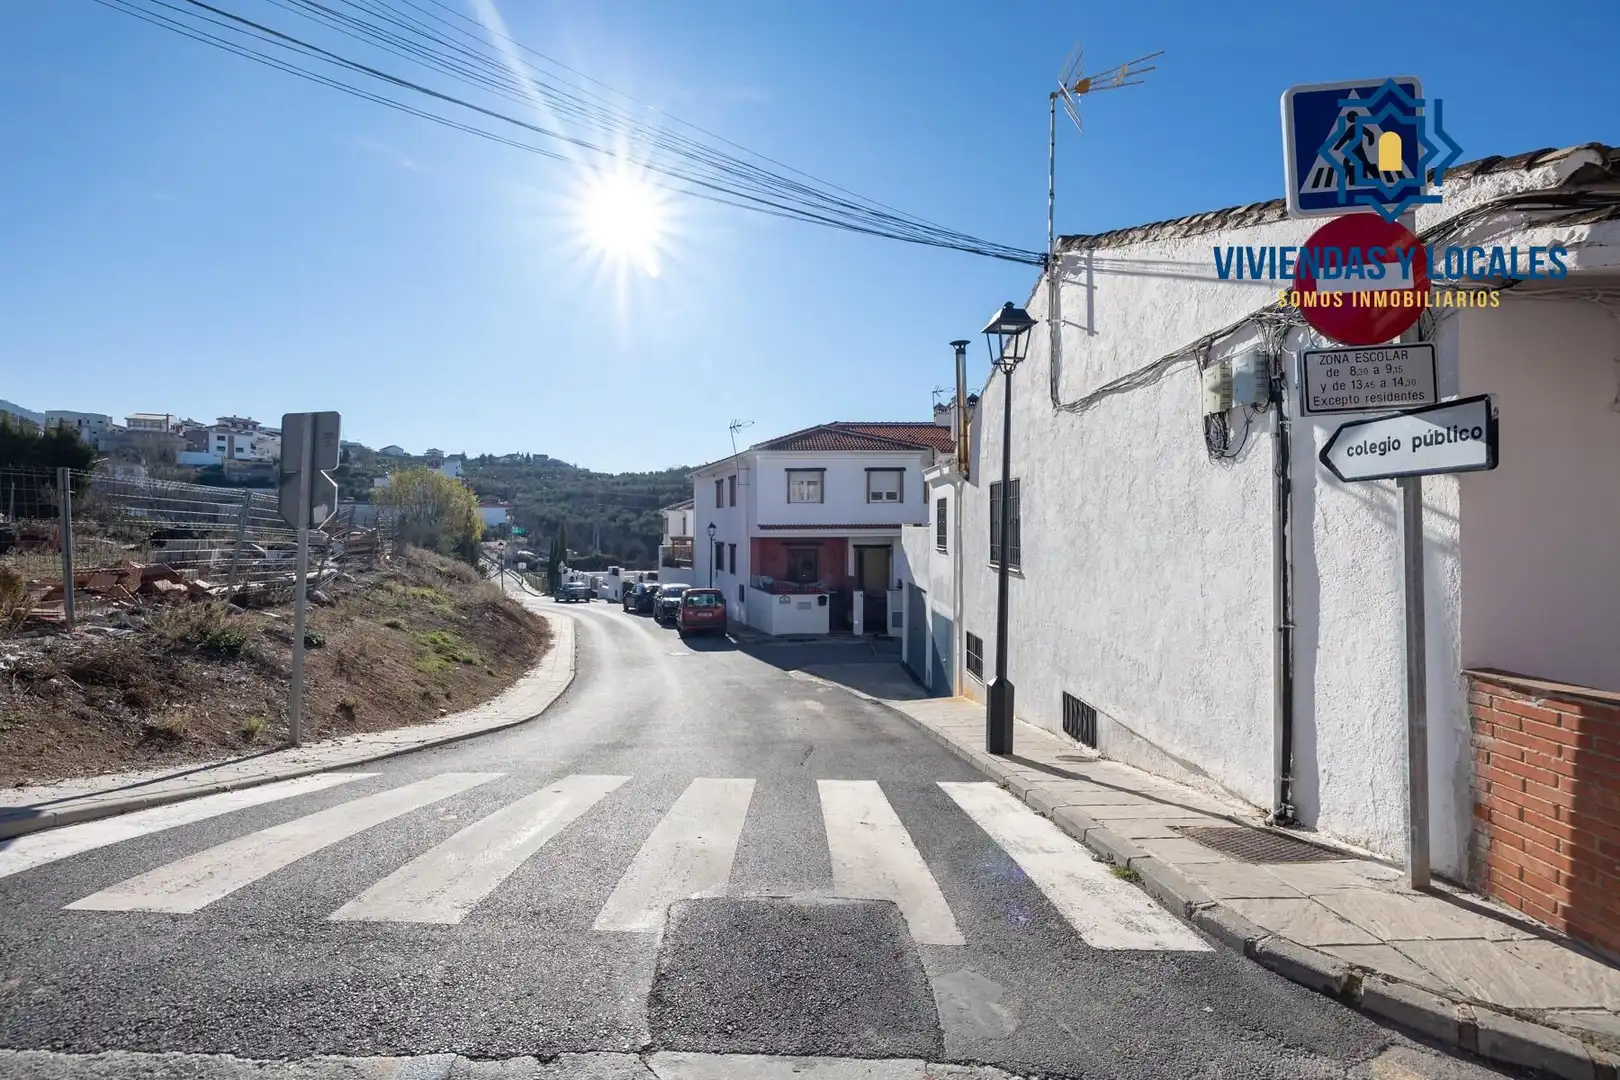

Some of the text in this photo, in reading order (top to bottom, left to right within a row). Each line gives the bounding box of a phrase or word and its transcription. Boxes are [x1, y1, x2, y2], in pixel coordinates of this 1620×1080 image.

[1319, 349, 1409, 366] ZONA ESCOLAR
[1326, 367, 1340, 378] de
[1373, 366, 1380, 375] a
[1320, 383, 1327, 394] y
[1332, 381, 1346, 391] de
[1380, 379, 1387, 388] a
[1313, 391, 1425, 407] Excepto residentes
[1346, 425, 1483, 457] colegio público
